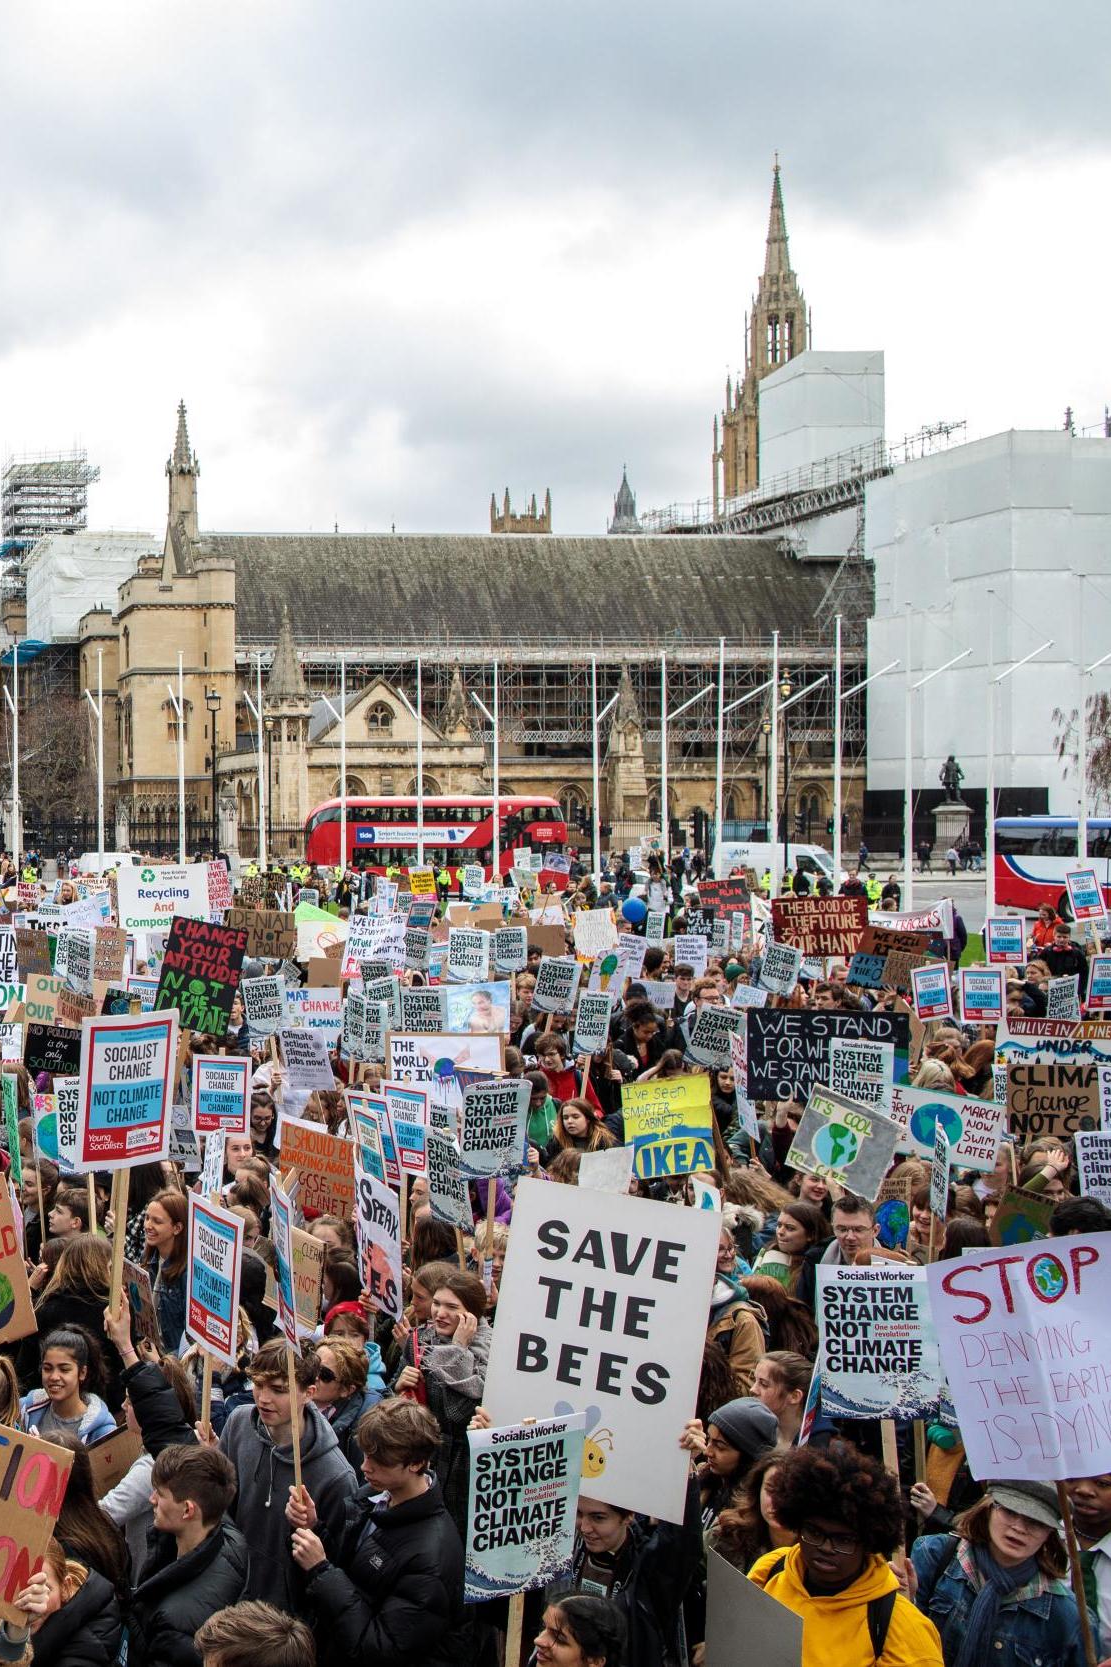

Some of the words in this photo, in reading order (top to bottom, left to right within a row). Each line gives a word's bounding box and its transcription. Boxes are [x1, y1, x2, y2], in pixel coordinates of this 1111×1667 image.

[138, 888, 189, 898] Recycling
[154, 902, 174, 912] And
[775, 902, 805, 914] THE
[804, 900, 839, 913] BLOOD
[842, 899, 858, 911] OF
[229, 910, 295, 930] DENIAL
[785, 915, 809, 927] THE
[809, 913, 862, 929] FUTURE
[173, 918, 249, 949] CHANGE
[872, 931, 891, 941] WE
[178, 938, 232, 965] YOUR
[256, 941, 295, 958] POLICY
[164, 950, 240, 986] ATTITUDE
[163, 972, 225, 998] NOT
[302, 1002, 340, 1012] CHANGE
[309, 1018, 341, 1027] HUMANS
[755, 1014, 801, 1035] WE
[812, 1015, 891, 1037] STAND
[1055, 1024, 1071, 1036] IN
[282, 1031, 314, 1041] Climate
[45, 1050, 62, 1059] only
[104, 1043, 158, 1063] SOCIALIST
[284, 1041, 311, 1050] action,
[286, 1049, 316, 1058] climate
[391, 1040, 414, 1052] THE
[764, 1037, 803, 1058] FOR
[1013, 1050, 1029, 1058] THE
[1036, 1040, 1093, 1053] UNDER
[287, 1057, 304, 1066] jobs
[306, 1058, 326, 1066] now!
[393, 1056, 429, 1067] WORLD
[751, 1060, 778, 1079] WE
[782, 1062, 830, 1081] STAND
[109, 1062, 152, 1080] CHANGE
[416, 1069, 432, 1082] IN
[93, 1091, 116, 1106] NOT
[119, 1084, 162, 1104] CLIMATE
[626, 1084, 650, 1099] I've
[654, 1084, 687, 1099] seen
[1011, 1087, 1090, 1114] Change
[106, 1104, 148, 1123] CHANGE
[624, 1103, 670, 1122] SMARTER
[638, 1112, 685, 1130] CABINETS
[813, 1097, 834, 1116] IT'S
[843, 1113, 871, 1136] COOL
[961, 1104, 1000, 1123] MARCH
[966, 1119, 993, 1132] NOW
[1009, 1112, 1058, 1134] NOT
[90, 1142, 124, 1150] Socialists
[294, 1130, 334, 1158] SHOULD
[963, 1131, 995, 1147] SWIM
[641, 1139, 713, 1179] IKEA
[956, 1144, 995, 1161] LATER
[332, 1183, 354, 1197] NOT
[304, 1191, 348, 1217] PLANET
[537, 1219, 687, 1284] SAVE
[837, 1270, 879, 1281] Socialist
[880, 1271, 915, 1281] Worker
[298, 1277, 317, 1293] NOT
[941, 1246, 1100, 1325] STOP
[822, 1286, 913, 1304] SYSTEM
[537, 1275, 657, 1340] THE
[823, 1303, 919, 1321] CHANGE
[825, 1321, 871, 1338] NOT
[874, 1323, 888, 1331] One
[889, 1323, 921, 1331] solution:
[875, 1330, 910, 1338] revolution
[825, 1339, 923, 1357] CLIMATE
[960, 1320, 1093, 1369] DENYING
[516, 1332, 671, 1406] BEES
[826, 1356, 921, 1374] CHANGE
[969, 1375, 1039, 1409] THE
[491, 1427, 534, 1445] Socialist
[535, 1422, 568, 1437] Worker
[978, 1414, 1023, 1465] IS
[476, 1439, 565, 1473] SYSTEM
[476, 1458, 567, 1492] CHANGE
[539, 1480, 568, 1492] solution:
[475, 1488, 522, 1513] NOT
[523, 1490, 558, 1503] revolution
[473, 1496, 567, 1533] CLIMATE
[472, 1517, 563, 1553] CHANGE
